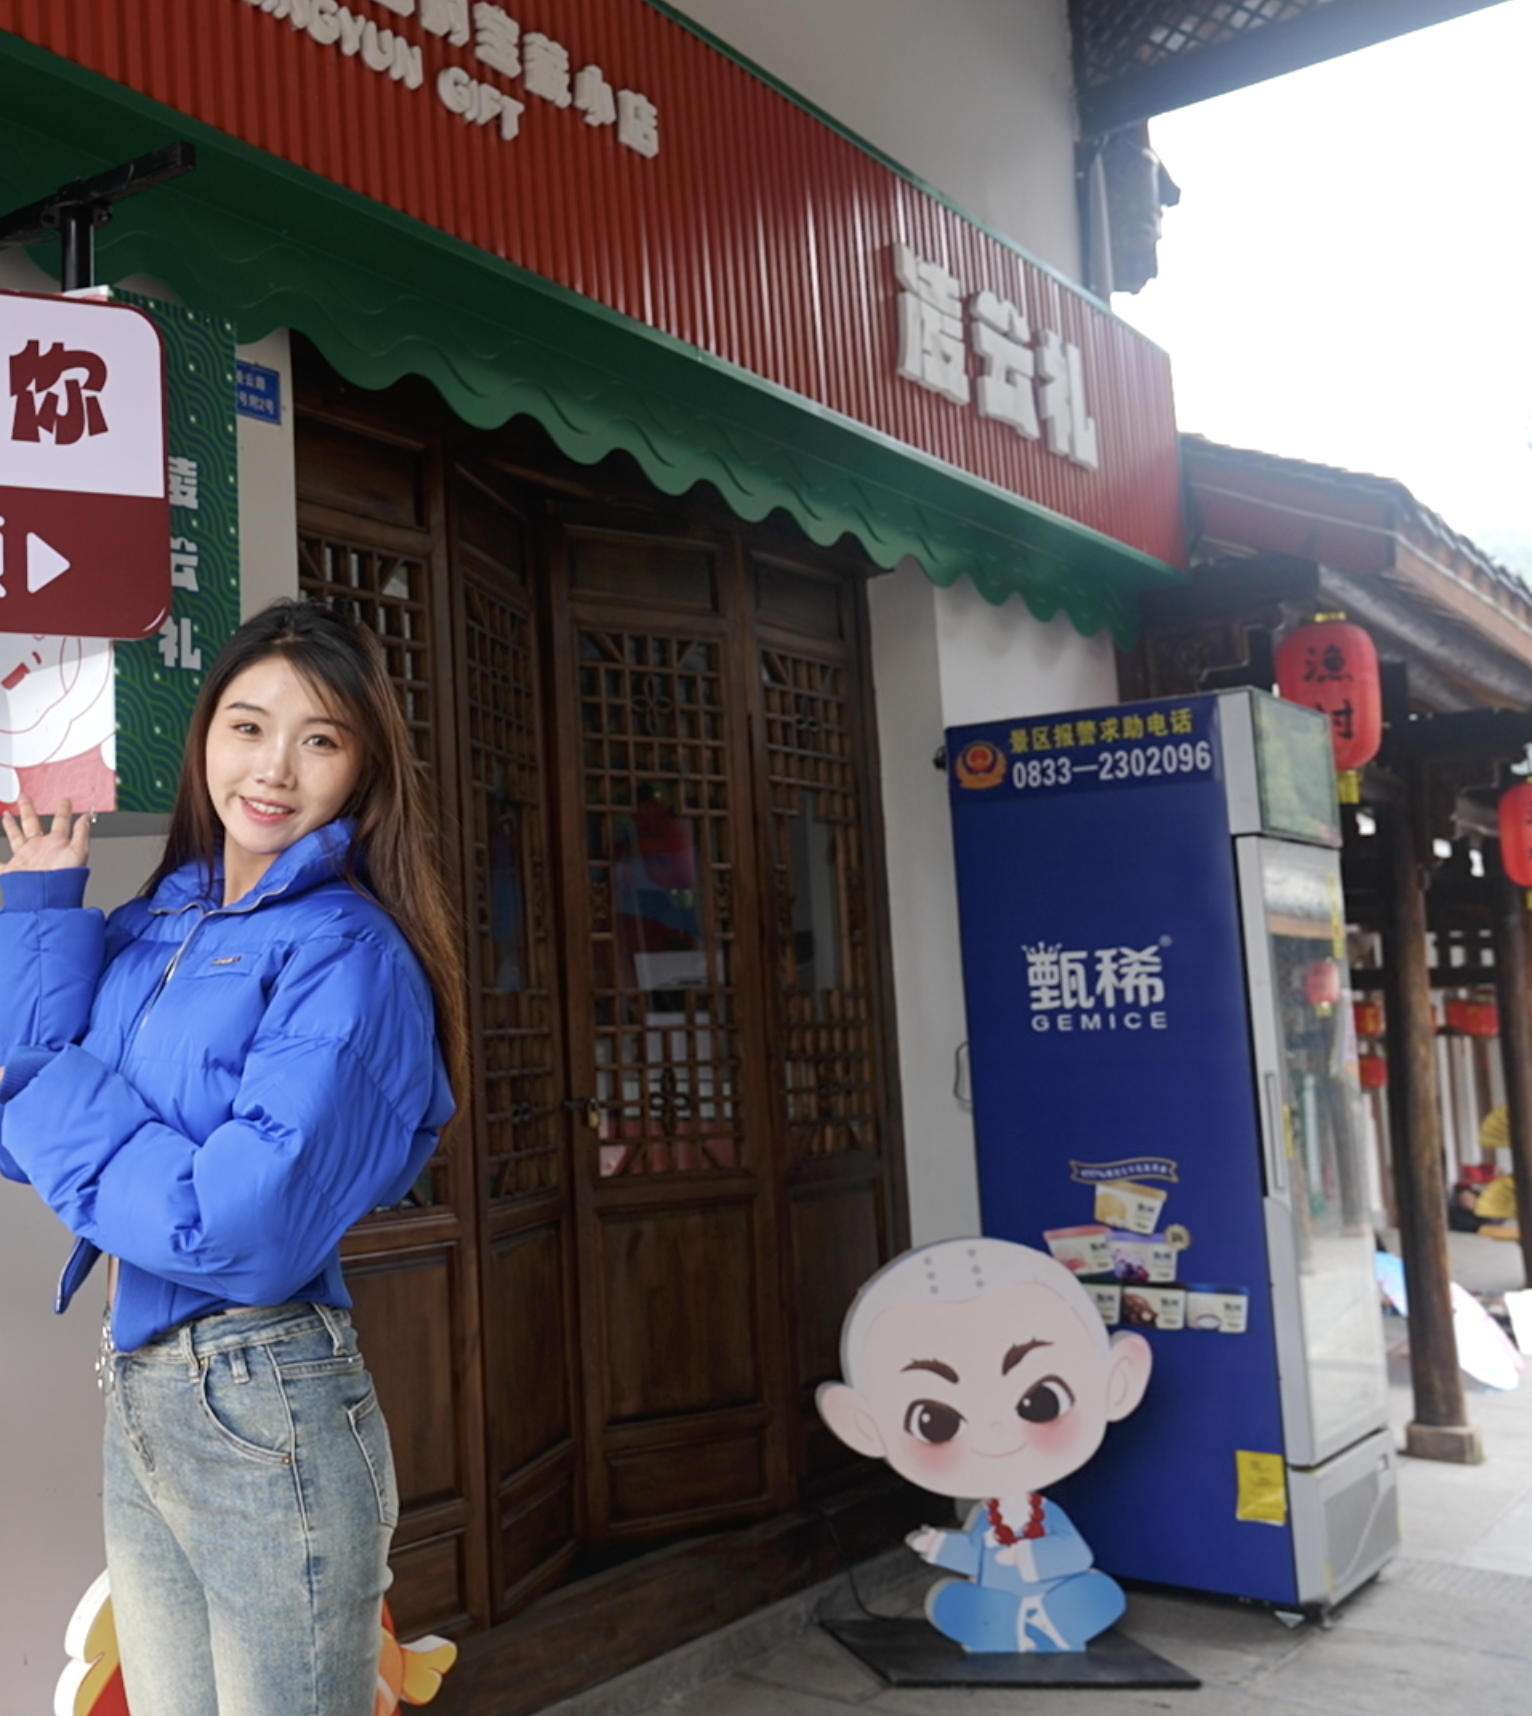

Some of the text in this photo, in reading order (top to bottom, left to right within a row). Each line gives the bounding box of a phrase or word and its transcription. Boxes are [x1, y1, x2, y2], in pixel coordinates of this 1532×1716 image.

[437, 66, 525, 141] GIFT
[1009, 707, 1193, 754] 景区报警求助电话
[1031, 1010, 1167, 1032] GEMICE
